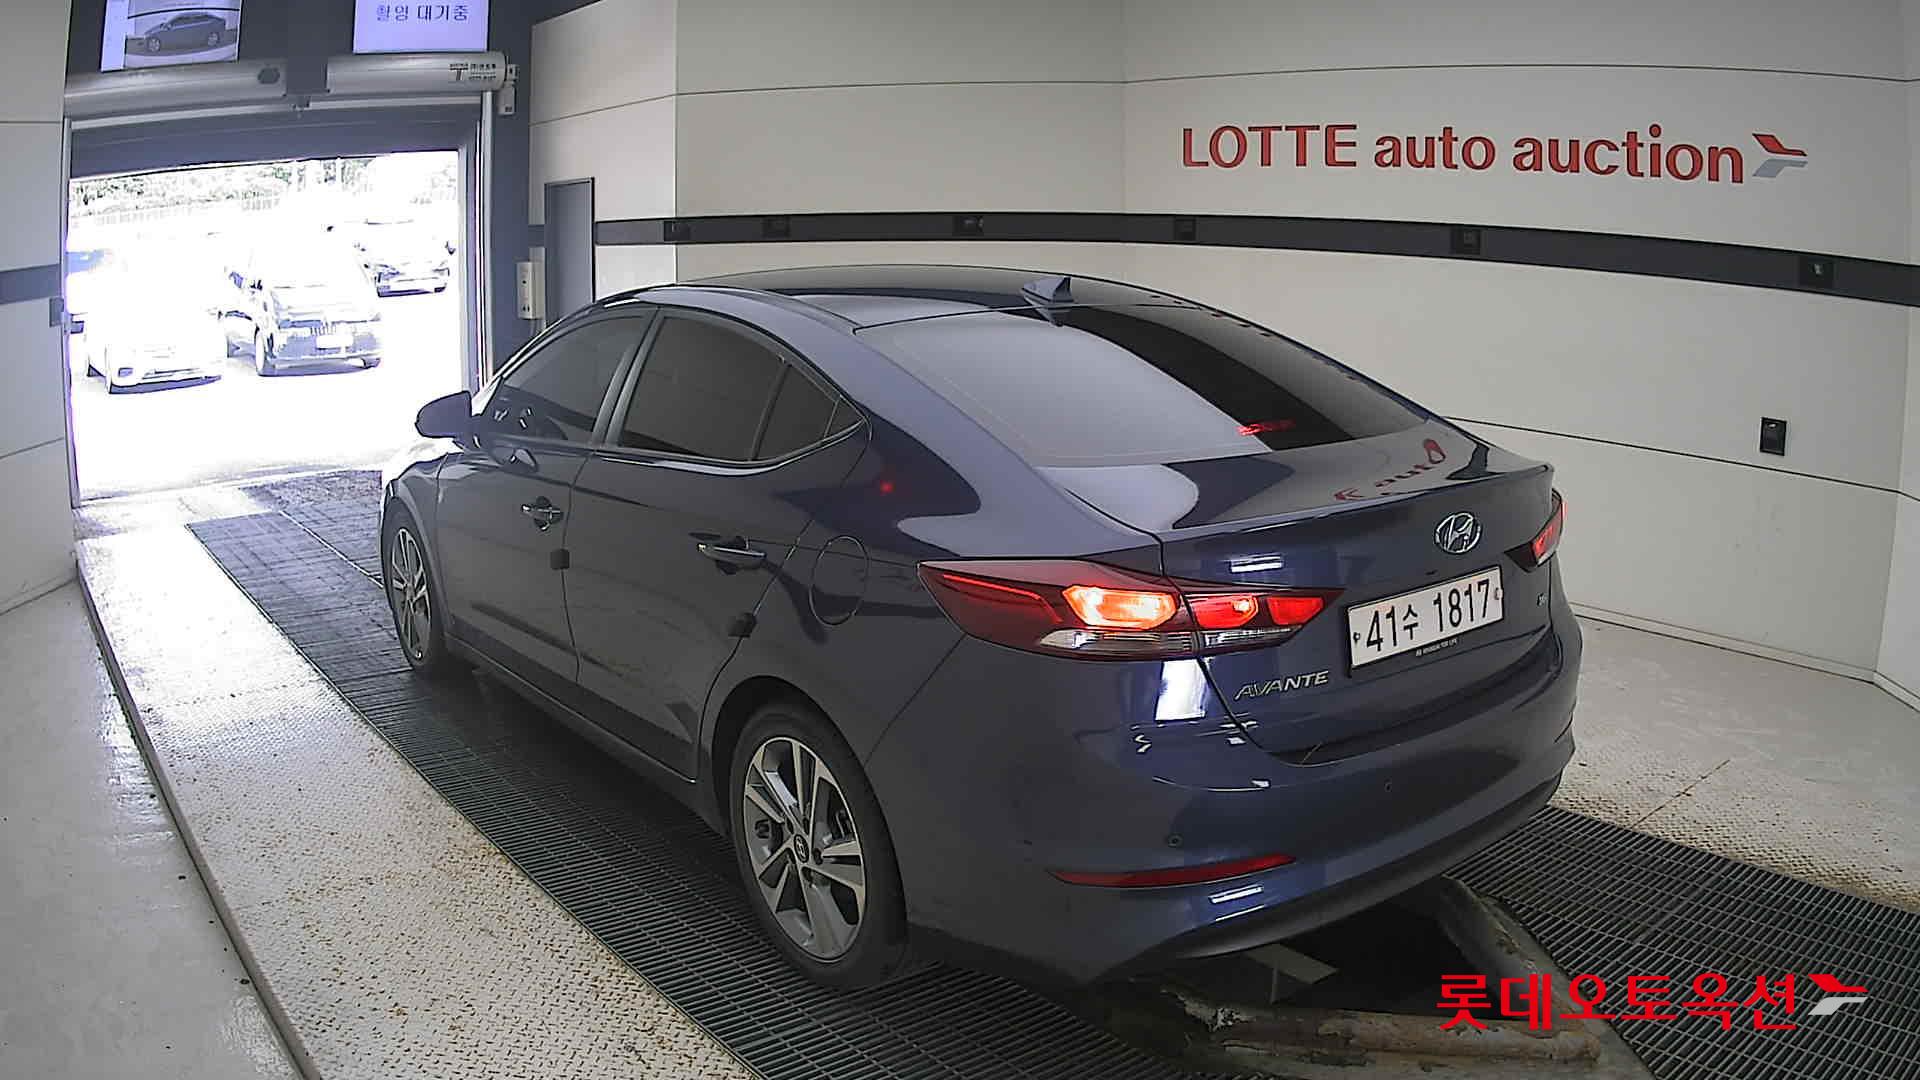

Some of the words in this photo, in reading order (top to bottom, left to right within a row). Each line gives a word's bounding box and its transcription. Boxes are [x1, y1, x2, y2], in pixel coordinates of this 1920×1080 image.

[416, 5, 469, 21] 대기중
[1183, 124, 1357, 168] LOTTE
[1374, 126, 1496, 170] auto
[1512, 123, 1744, 184] auction
[1366, 604, 1419, 652] 41수
[1433, 578, 1490, 632] 1817
[1233, 670, 1330, 701] AVANTE
